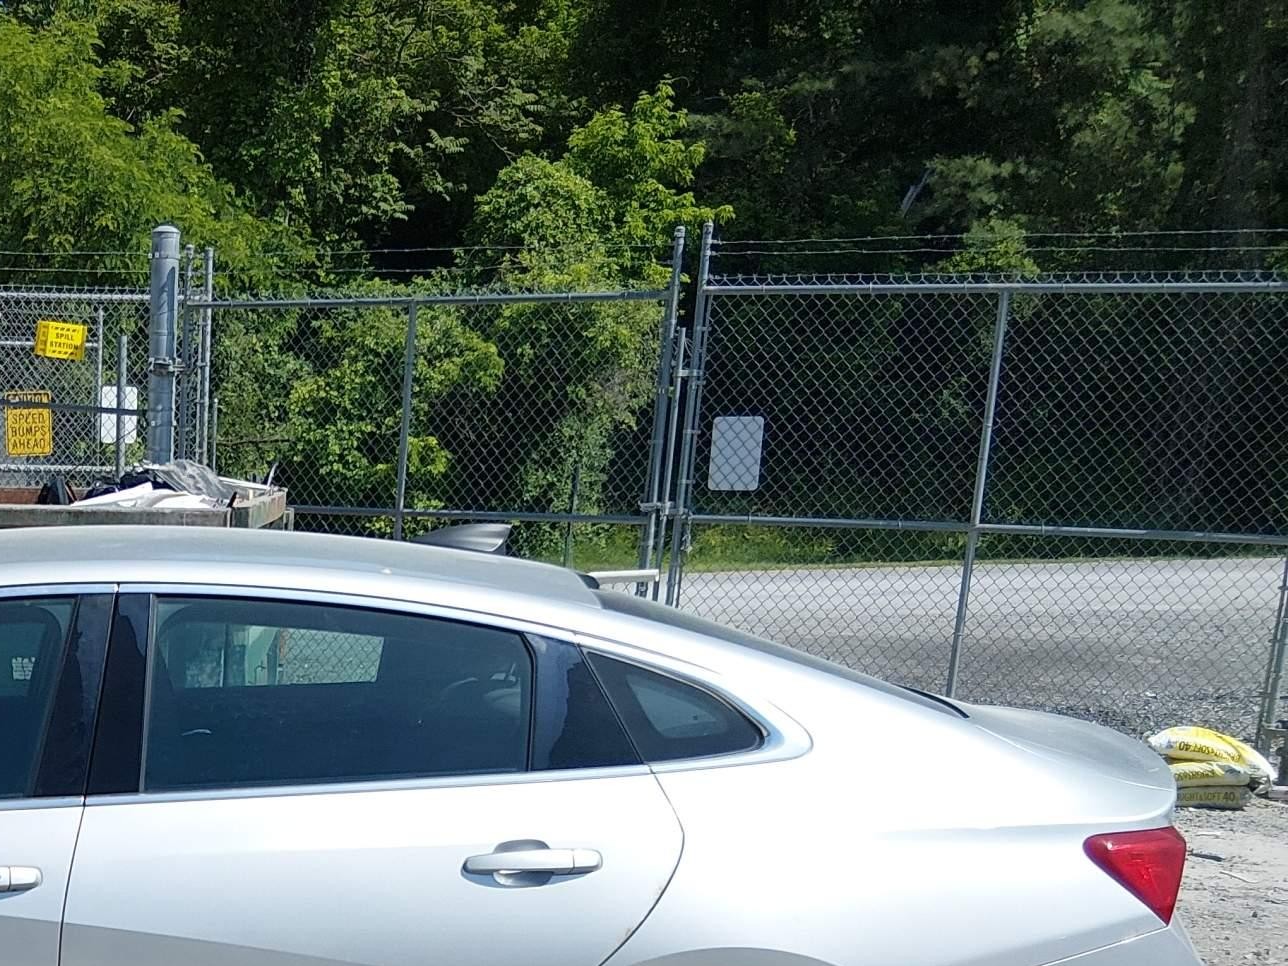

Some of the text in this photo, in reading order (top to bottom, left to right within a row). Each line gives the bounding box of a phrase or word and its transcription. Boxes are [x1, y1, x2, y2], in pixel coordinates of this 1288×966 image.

[55, 332, 75, 341] SPILL
[49, 341, 79, 350] STATION
[11, 412, 46, 425] SPEED
[10, 425, 48, 438] BUMPS
[11, 438, 46, 451] AHEAD
[1223, 791, 1236, 802] 40
